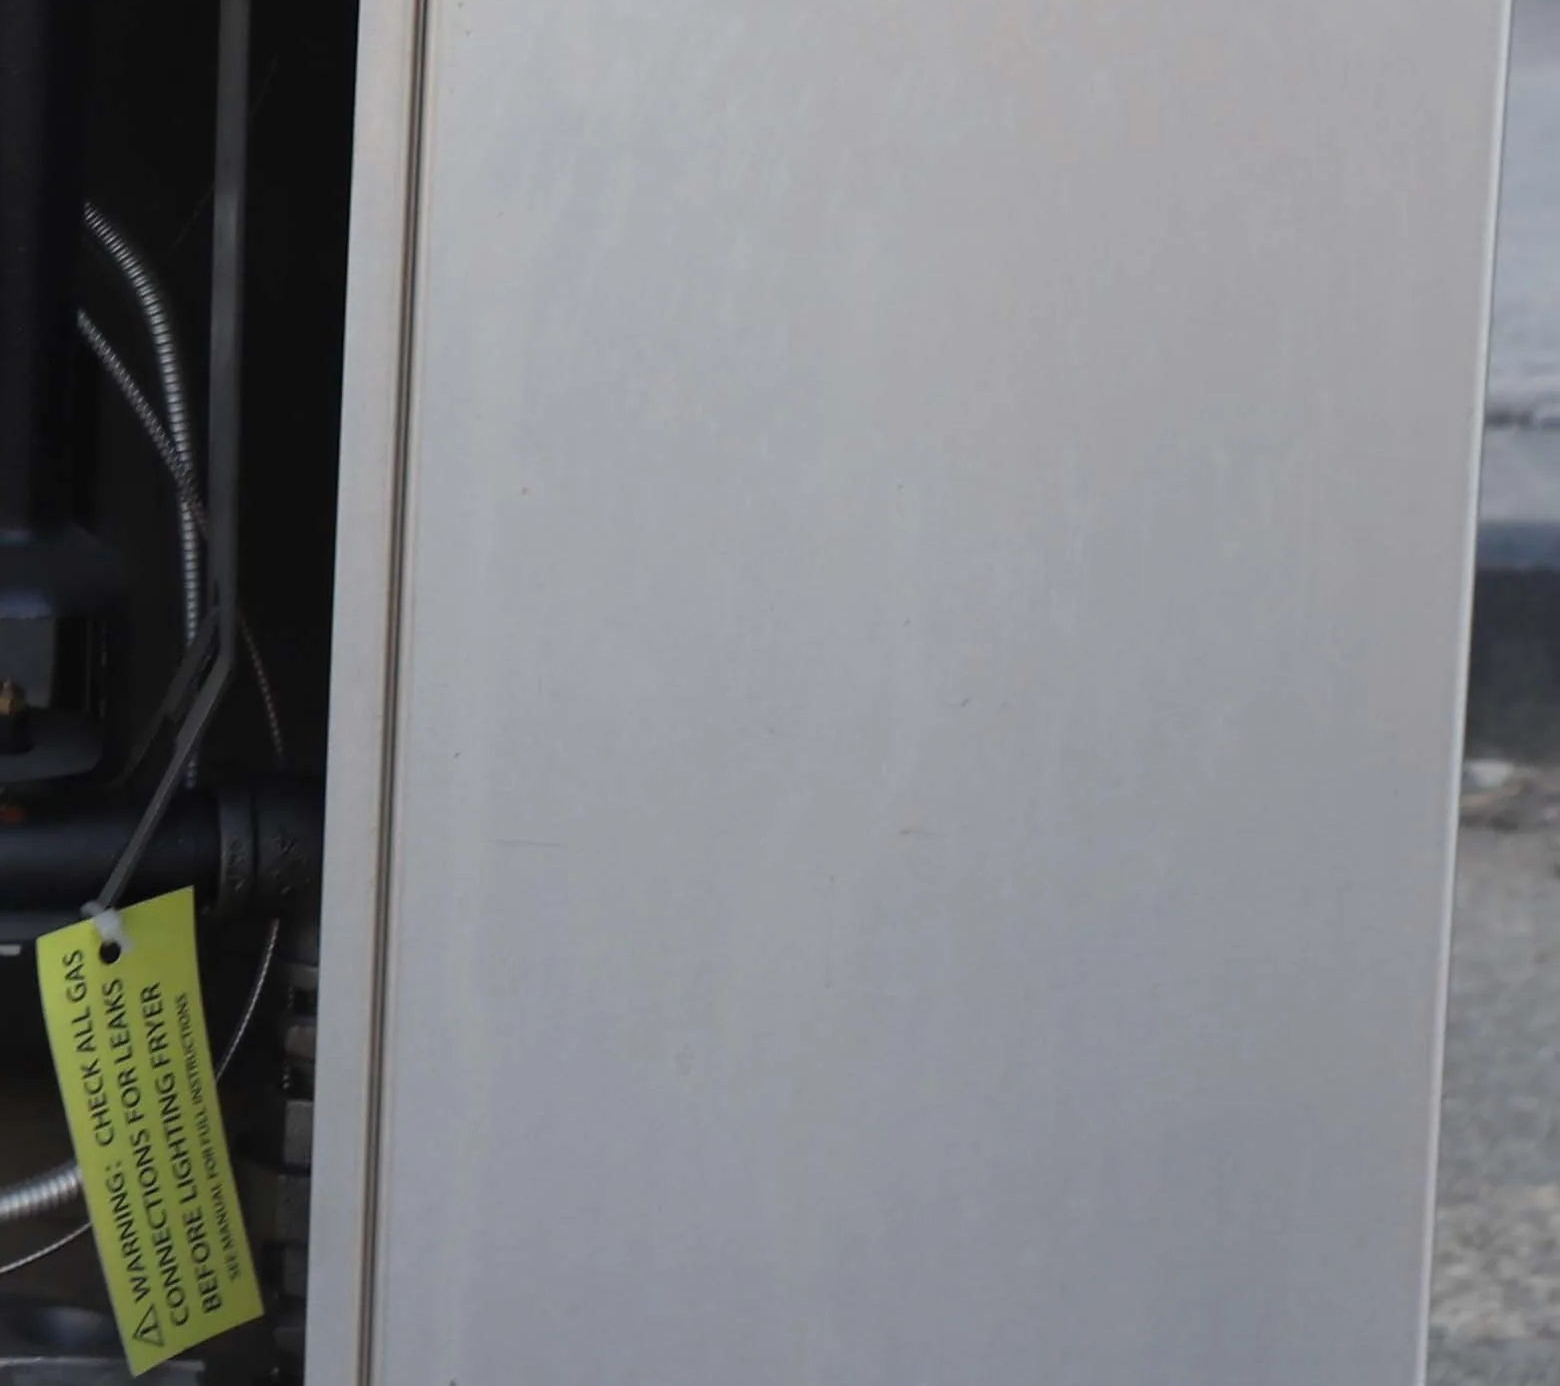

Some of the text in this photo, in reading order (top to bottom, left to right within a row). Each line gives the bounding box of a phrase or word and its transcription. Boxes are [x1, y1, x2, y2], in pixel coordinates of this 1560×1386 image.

[175, 992, 203, 1106] INSTRUCTIONS
[61, 949, 151, 1303] WARNING: CHECK ALL GAS
[102, 978, 190, 1326] CONNECTIONS FOR LEAKS
[140, 981, 222, 1314] BEFORE LIGHTING FRYER
[194, 1106, 213, 1145] FULL
[201, 1146, 219, 1180] FOR
[210, 1183, 235, 1252] MANUAL
